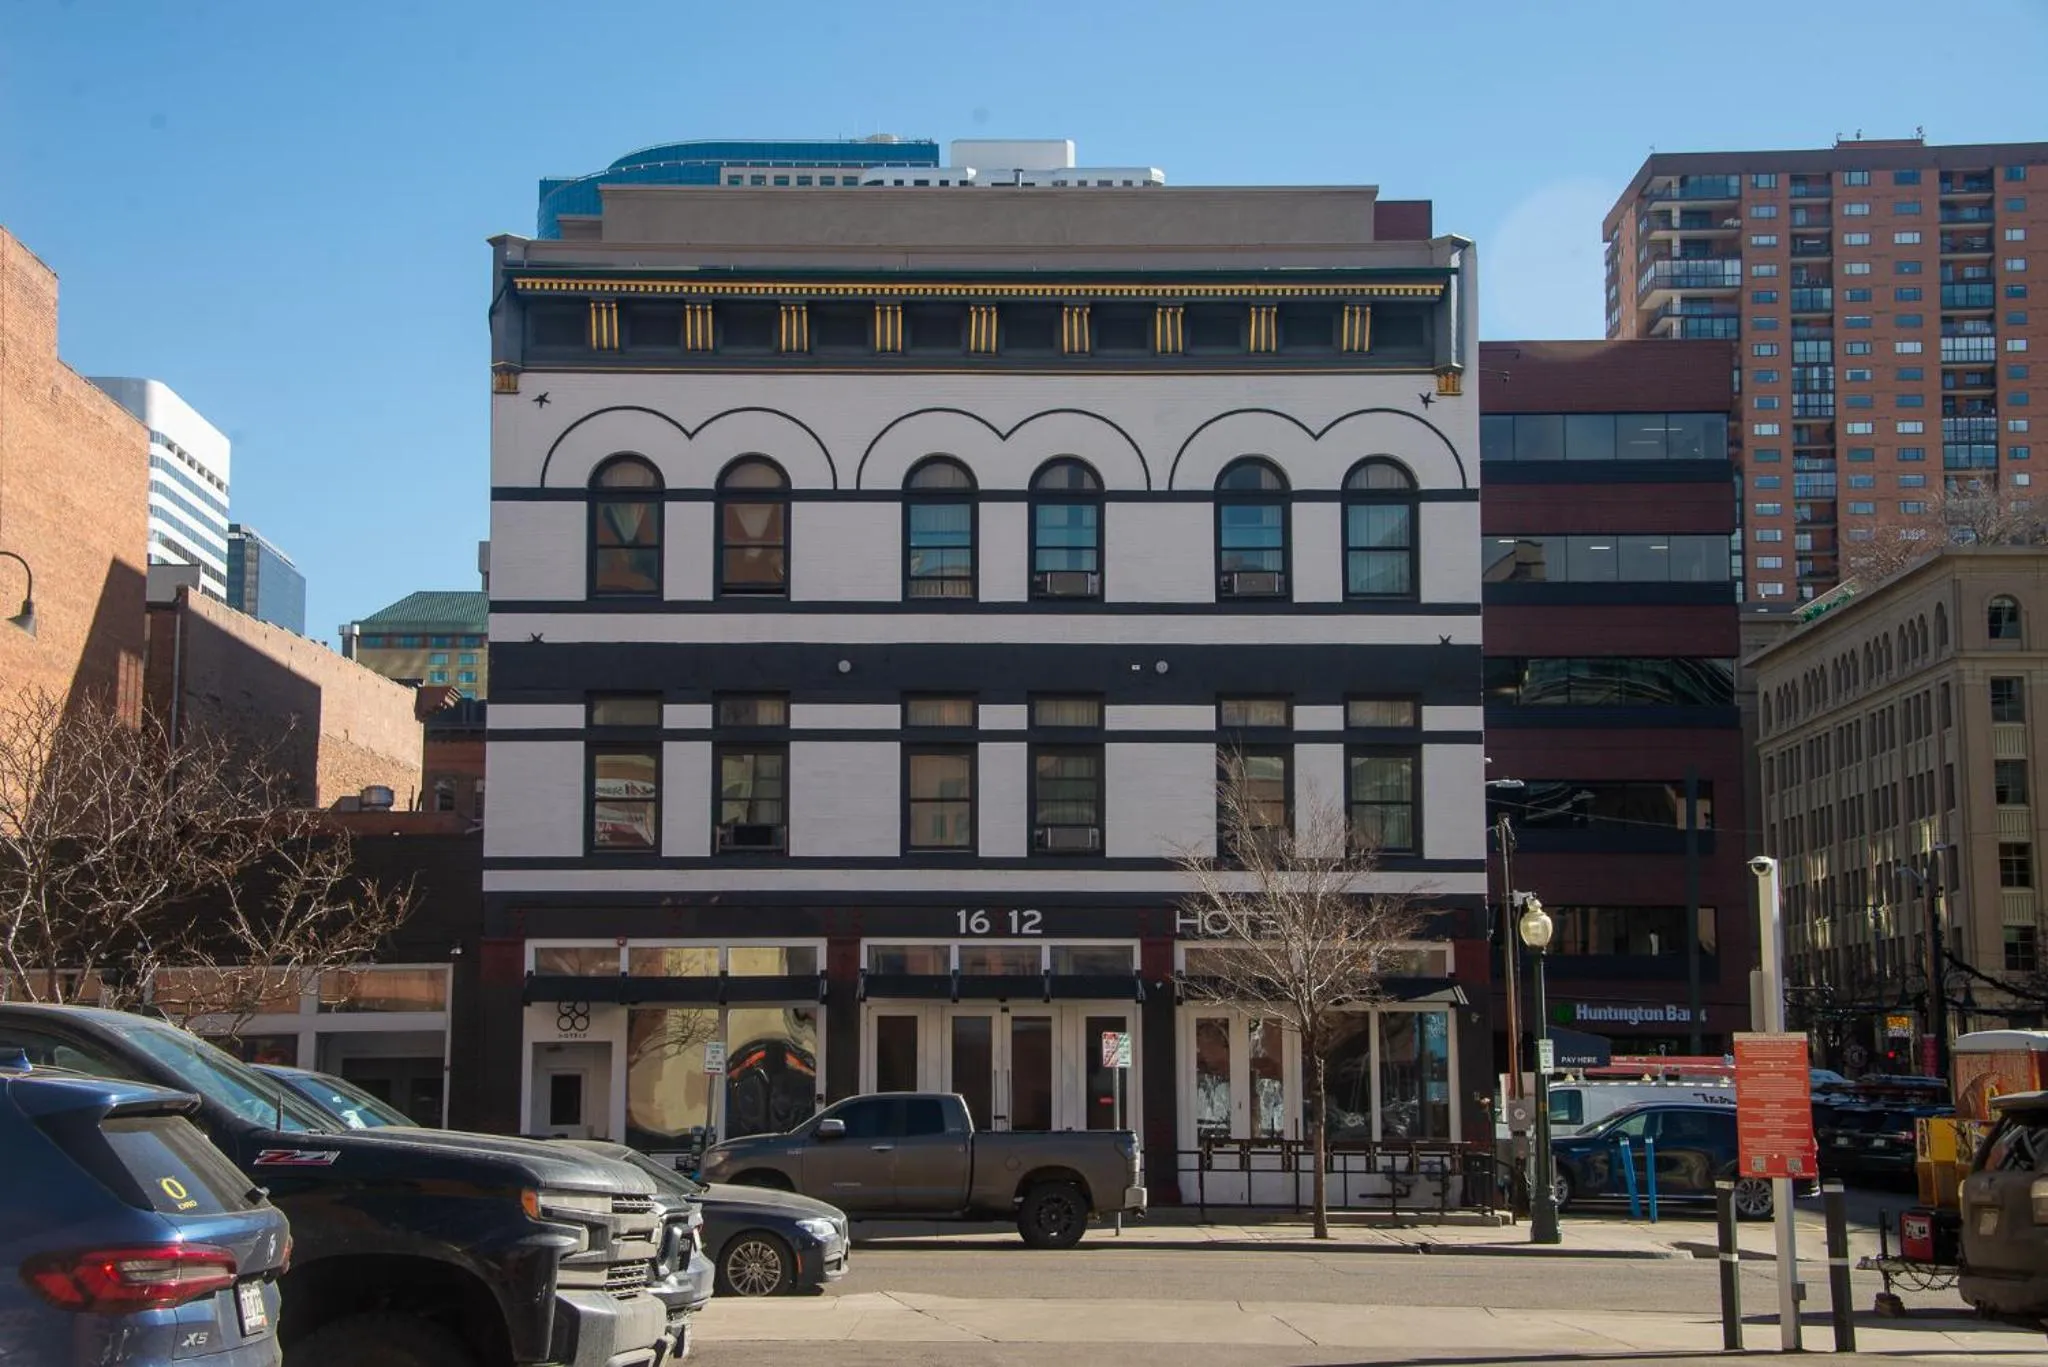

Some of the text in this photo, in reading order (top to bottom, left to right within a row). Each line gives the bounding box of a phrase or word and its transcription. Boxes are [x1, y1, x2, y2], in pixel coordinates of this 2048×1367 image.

[956, 909, 1043, 934] 16 12
[1576, 1004, 1664, 1025] Huntington
[1561, 1056, 1598, 1064] PAY HERE
[181, 1331, 209, 1346] X5
